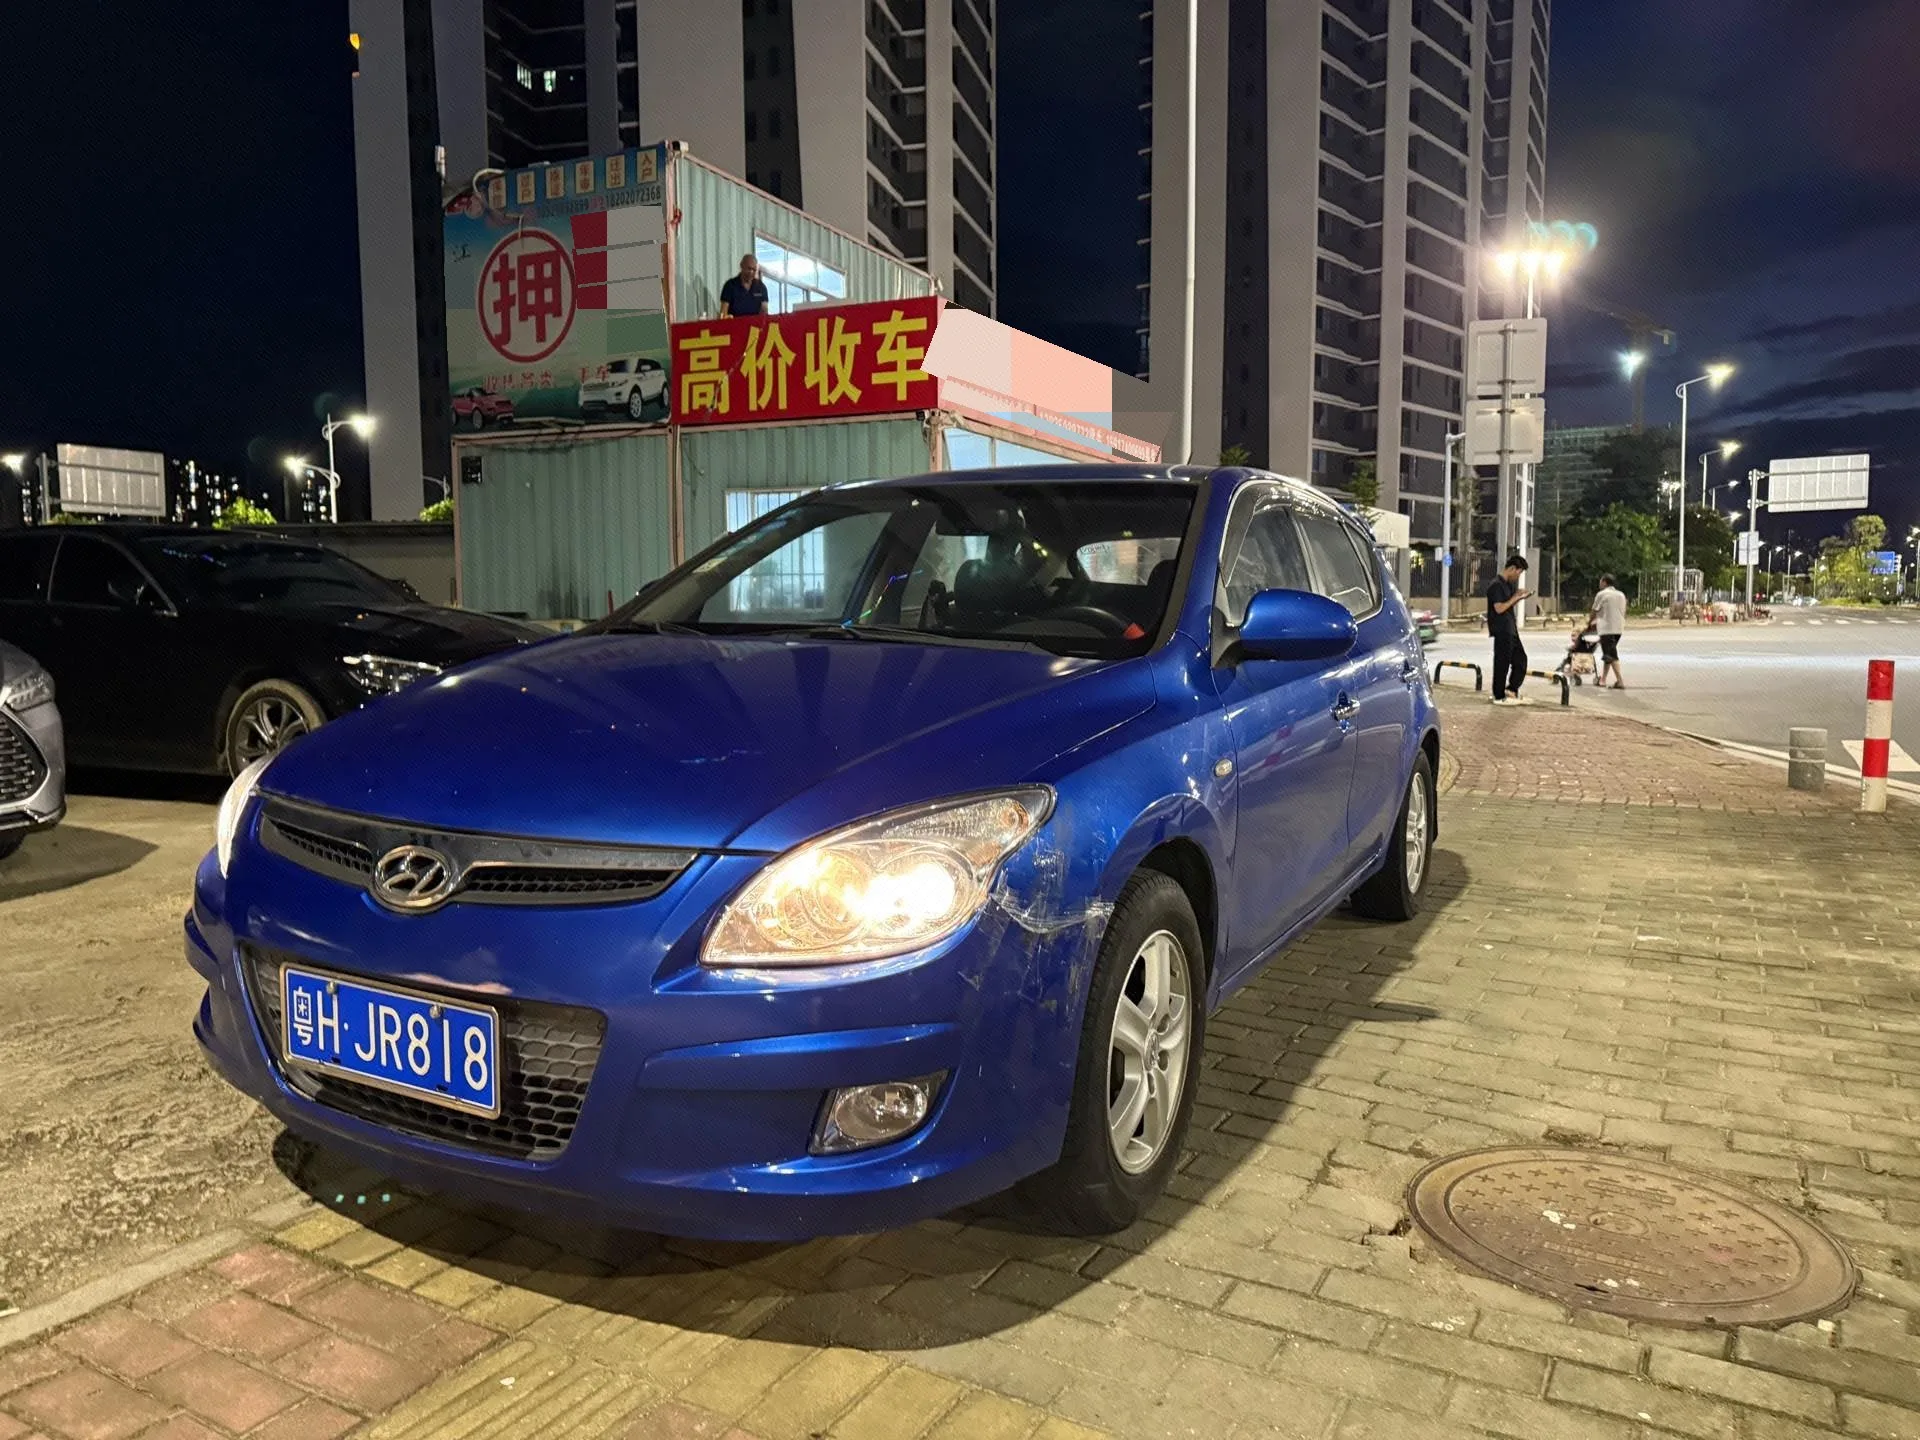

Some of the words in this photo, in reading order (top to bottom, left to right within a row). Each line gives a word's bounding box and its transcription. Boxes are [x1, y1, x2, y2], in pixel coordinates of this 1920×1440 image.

[492, 250, 563, 346] 押
[679, 310, 929, 415] 高价收车
